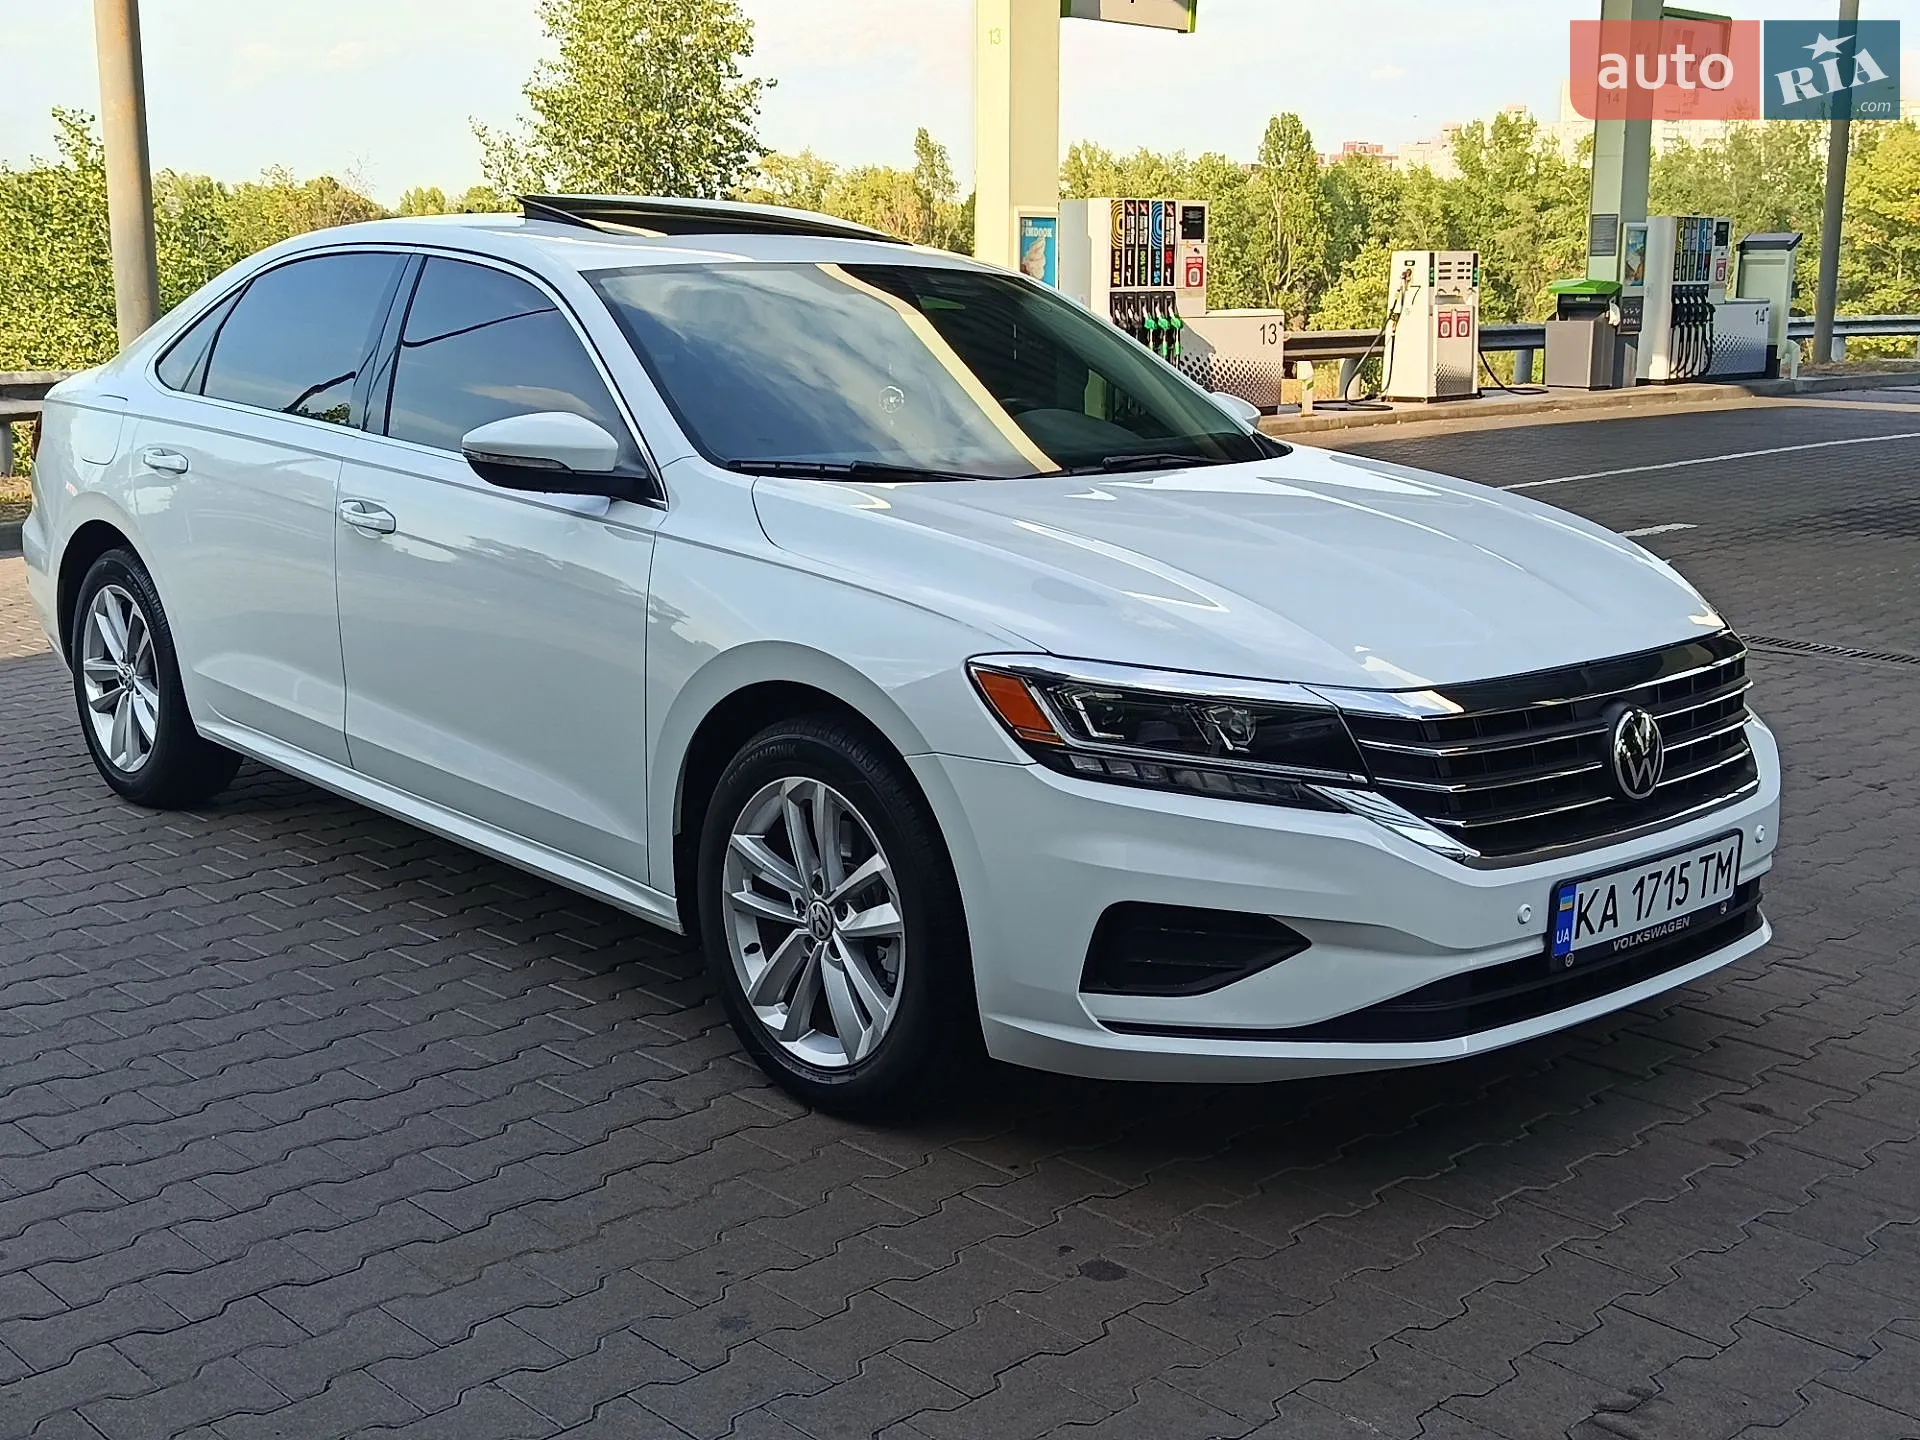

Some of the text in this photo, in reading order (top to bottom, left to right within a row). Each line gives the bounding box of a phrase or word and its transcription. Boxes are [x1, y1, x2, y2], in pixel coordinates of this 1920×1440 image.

[1606, 93, 1620, 105] 14
[1410, 285, 1421, 305] 7
[1754, 308, 1766, 326] 14
[1260, 324, 1278, 346] 13
[1575, 846, 1735, 940] KA 1715 TM
[1556, 928, 1570, 945] UA
[1613, 916, 1690, 952] VOLKSWAGEN
